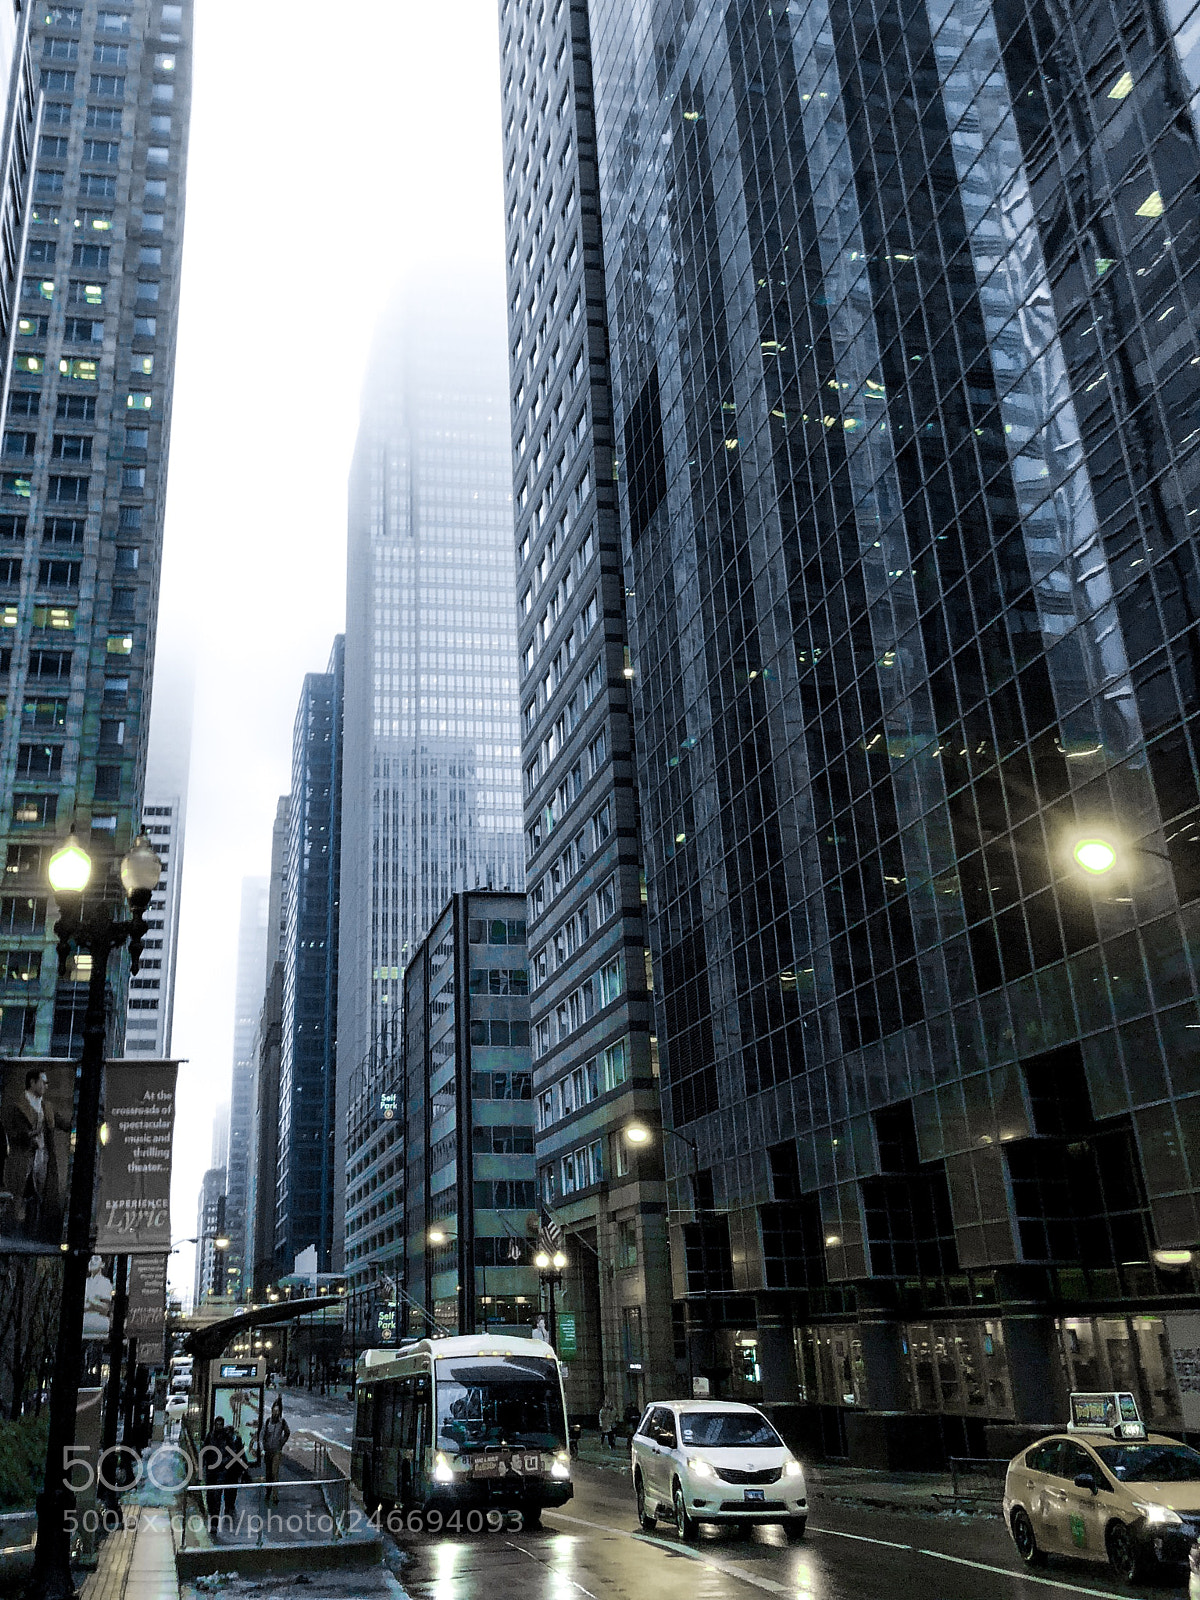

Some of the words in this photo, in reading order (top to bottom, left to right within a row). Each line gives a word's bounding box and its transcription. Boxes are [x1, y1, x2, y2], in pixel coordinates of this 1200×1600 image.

[143, 1090, 156, 1100] At
[157, 1089, 172, 1100] the
[381, 1093, 397, 1102] Self
[112, 1104, 160, 1115] crossroads
[161, 1103, 172, 1114] of
[380, 1101, 398, 1110] Park
[119, 1118, 171, 1132] spectacular
[124, 1133, 151, 1143] music
[152, 1131, 170, 1143] and
[133, 1146, 170, 1160] thrilling
[105, 1199, 169, 1210] EXPERIENCE
[104, 1208, 168, 1233] Lyric
[379, 1311, 395, 1320] Self
[377, 1320, 396, 1329] Park
